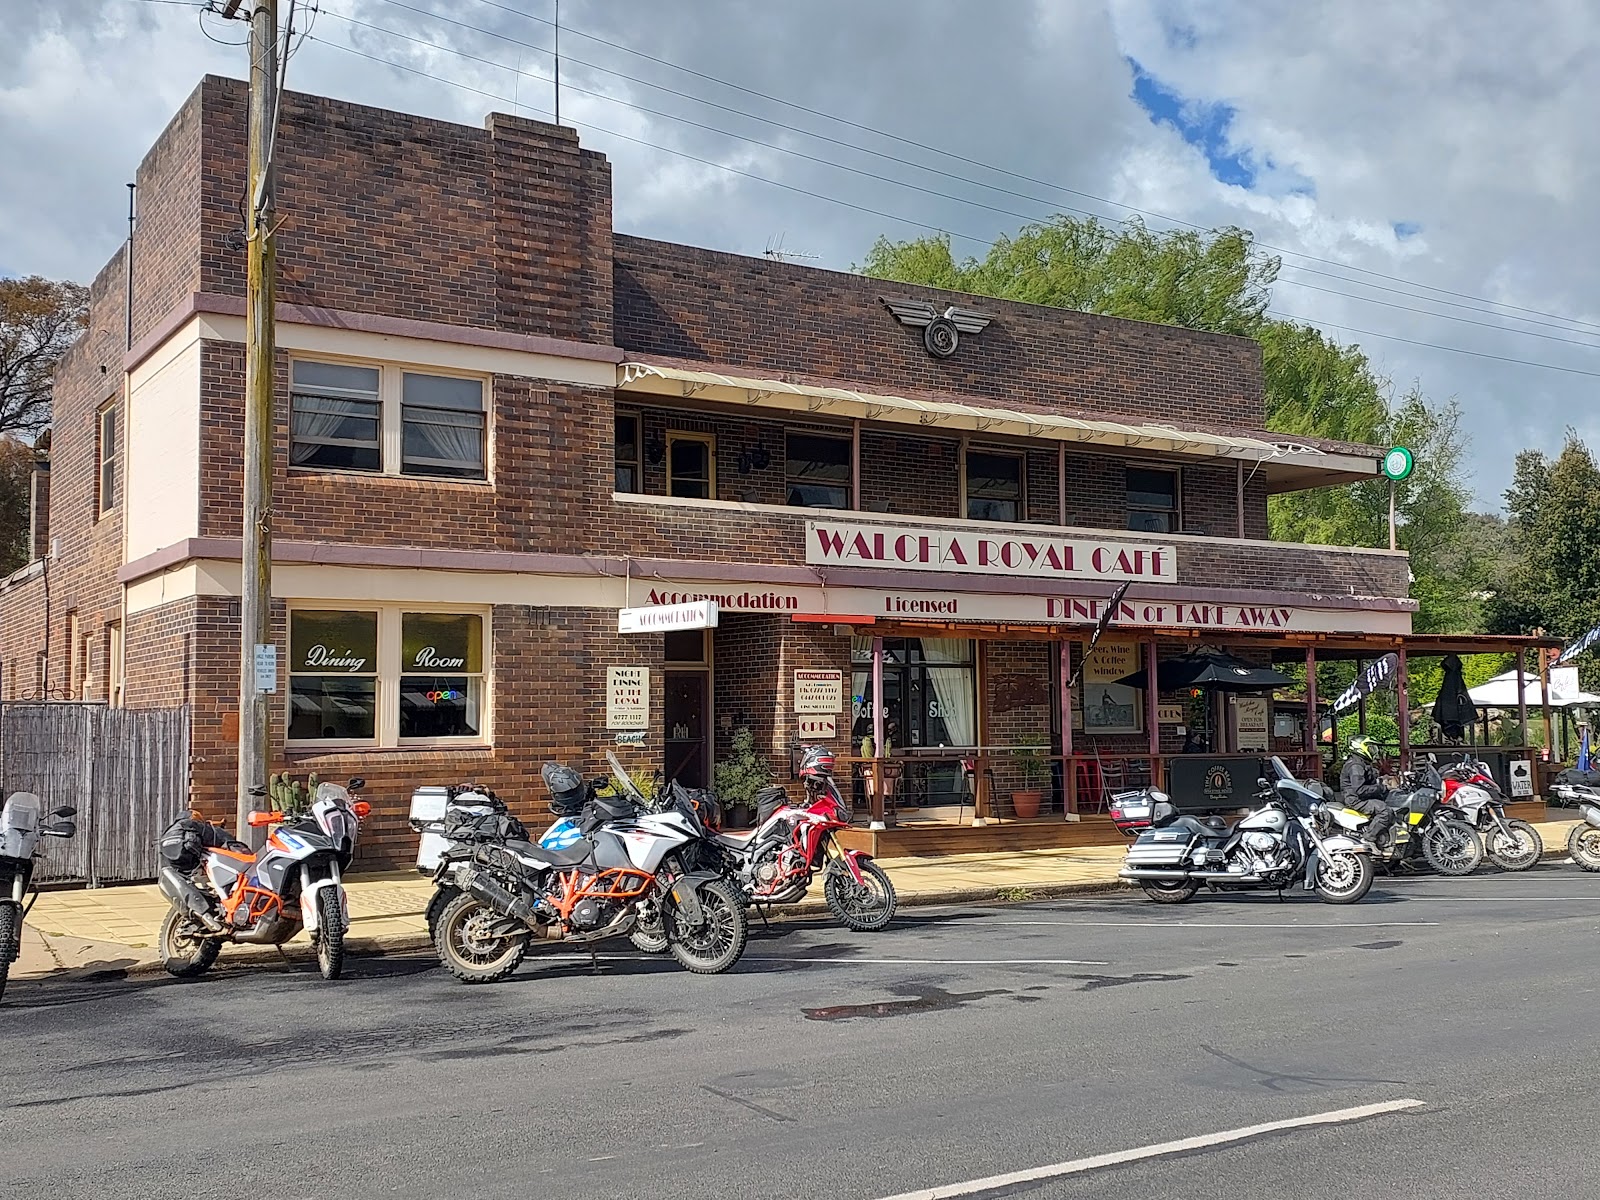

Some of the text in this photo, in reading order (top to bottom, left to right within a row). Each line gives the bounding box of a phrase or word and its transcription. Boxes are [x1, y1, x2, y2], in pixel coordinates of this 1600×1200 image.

[816, 528, 1170, 577] WALCHA ROYAL CAFÉ
[885, 597, 958, 614] Licensed
[639, 609, 705, 627] ACCOMMODATION
[1046, 598, 1103, 620] DINE
[1143, 605, 1167, 623] or
[1174, 604, 1230, 625] TAKE
[1234, 607, 1294, 628] AWAY
[1110, 645, 1130, 653] Wine
[305, 644, 367, 672] Dining
[413, 646, 465, 668] Room
[1101, 656, 1126, 664] Coffee
[1093, 667, 1125, 675] window
[426, 690, 457, 703] open
[852, 701, 956, 718] Cofe Shop
[1158, 710, 1181, 718] OPEN
[801, 722, 835, 732] OPEN
[618, 735, 640, 743] BEACH
[1512, 781, 1531, 789] WATER
